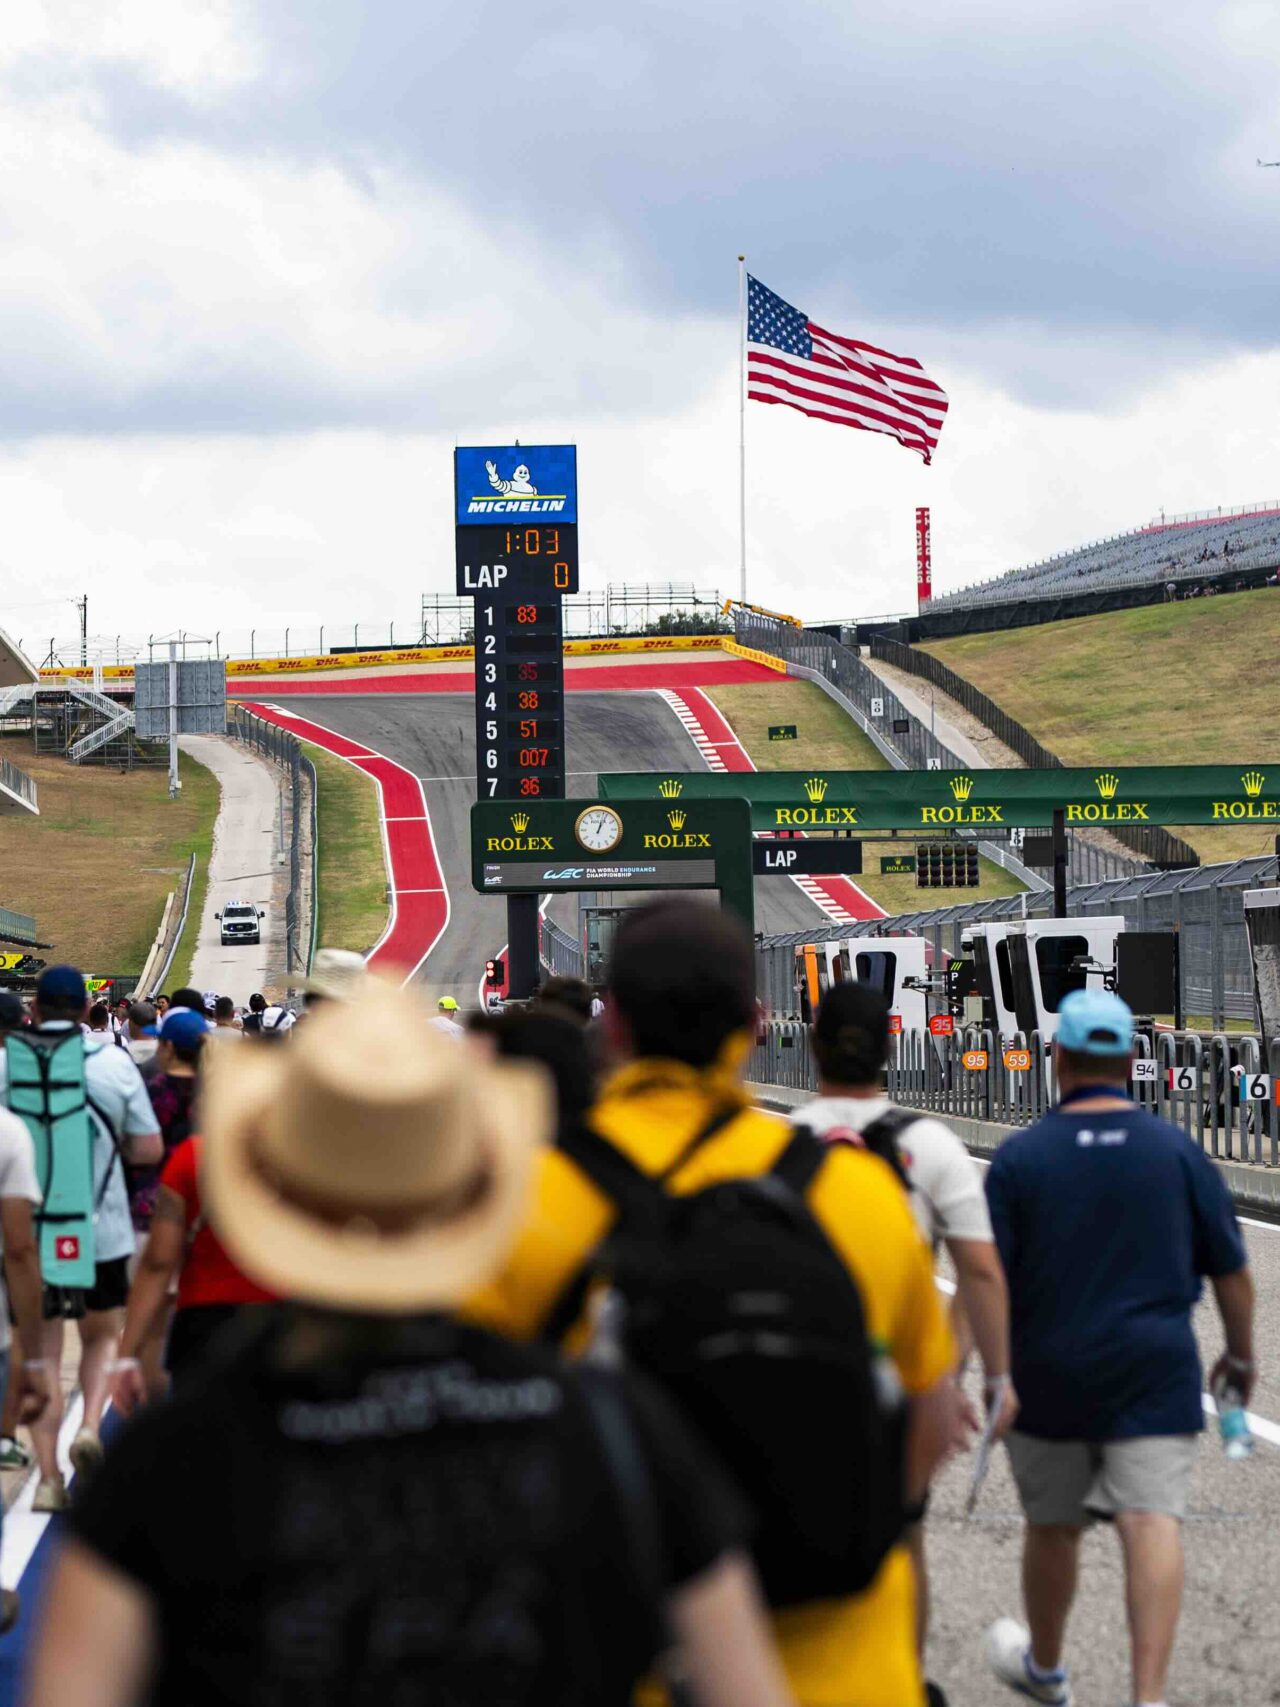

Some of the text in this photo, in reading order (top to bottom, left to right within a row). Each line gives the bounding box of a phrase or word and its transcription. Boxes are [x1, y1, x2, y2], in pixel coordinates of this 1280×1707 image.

[467, 500, 565, 513] MICHELIN
[506, 529, 559, 555] 1:03
[464, 565, 508, 588] LAP
[554, 562, 569, 588] 0
[484, 606, 494, 626] 1
[517, 606, 537, 624] 83
[484, 635, 496, 654] 2
[590, 643, 620, 651] DHL
[644, 640, 674, 648] DHL
[692, 639, 721, 647] DHL
[359, 655, 382, 663] DHL
[397, 652, 422, 660] DHL
[442, 649, 473, 657] DHL
[237, 663, 261, 671] DHL
[278, 661, 302, 669] DHL
[316, 658, 339, 666] DHL
[485, 664, 497, 683] 3
[485, 692, 497, 711] 4
[518, 692, 539, 709] 38
[486, 721, 498, 740] 5
[520, 721, 537, 738] 51
[486, 749, 498, 768] 6
[520, 749, 549, 766] 007
[487, 778, 498, 797] 7
[520, 778, 539, 795] 36
[775, 807, 858, 825] ROLEX
[921, 806, 1004, 823] ROLEX
[1067, 803, 1149, 821] ROLEX
[1212, 801, 1280, 819] ROLE
[487, 837, 555, 851] ROLEX
[643, 833, 711, 848] ROLEX
[765, 850, 797, 867] LAP
[542, 868, 584, 881] WEC
[951, 972, 959, 982] P
[935, 1019, 951, 1031] 35
[967, 1054, 985, 1067] 95
[1008, 1053, 1028, 1067] 59
[1136, 1063, 1155, 1076] 94
[1177, 1067, 1193, 1090] 6
[1250, 1074, 1267, 1099] 6
